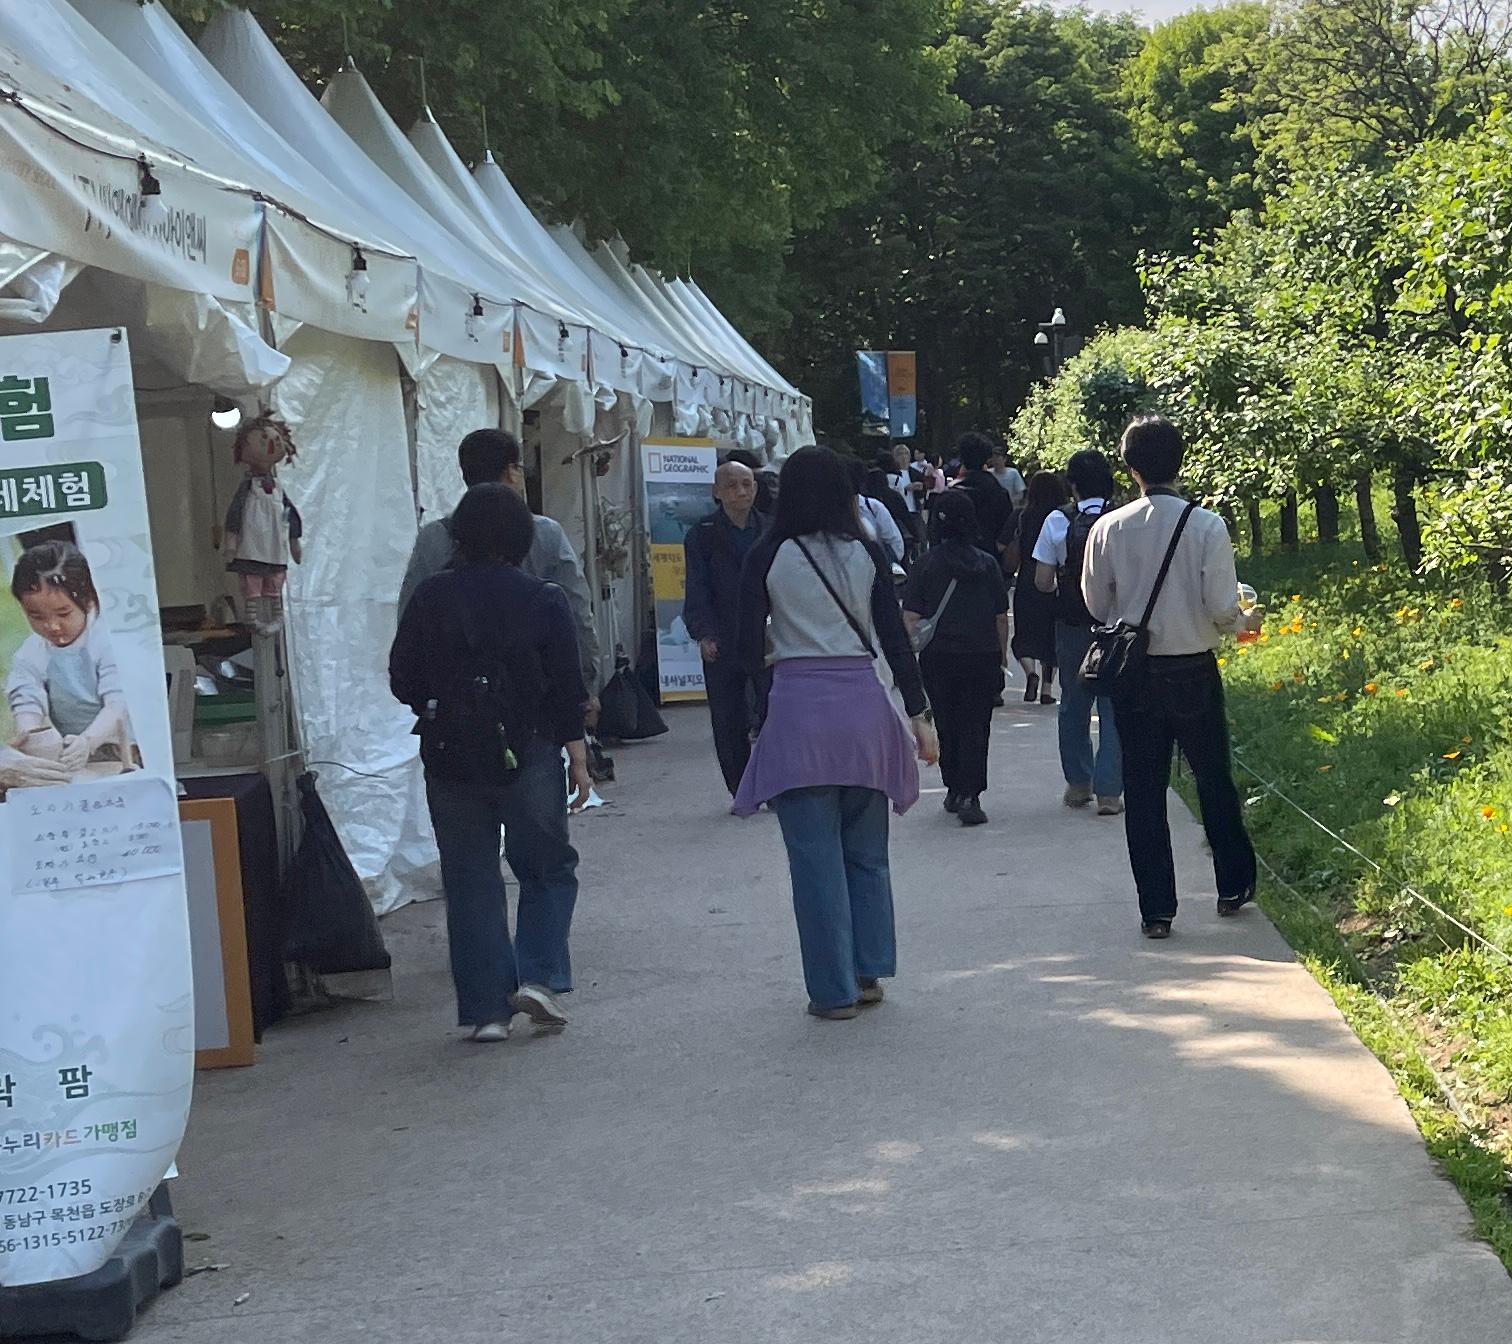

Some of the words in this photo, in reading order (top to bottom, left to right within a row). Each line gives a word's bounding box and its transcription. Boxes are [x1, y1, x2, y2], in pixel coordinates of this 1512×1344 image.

[663, 455, 699, 464] NATIONAL
[664, 463, 709, 474] GEOGRAPHIC
[58, 1064, 93, 1100] 팜
[3, 1210, 47, 1231] 동남구
[51, 1203, 96, 1223] 목천읍
[100, 1195, 136, 1214] 도장로
